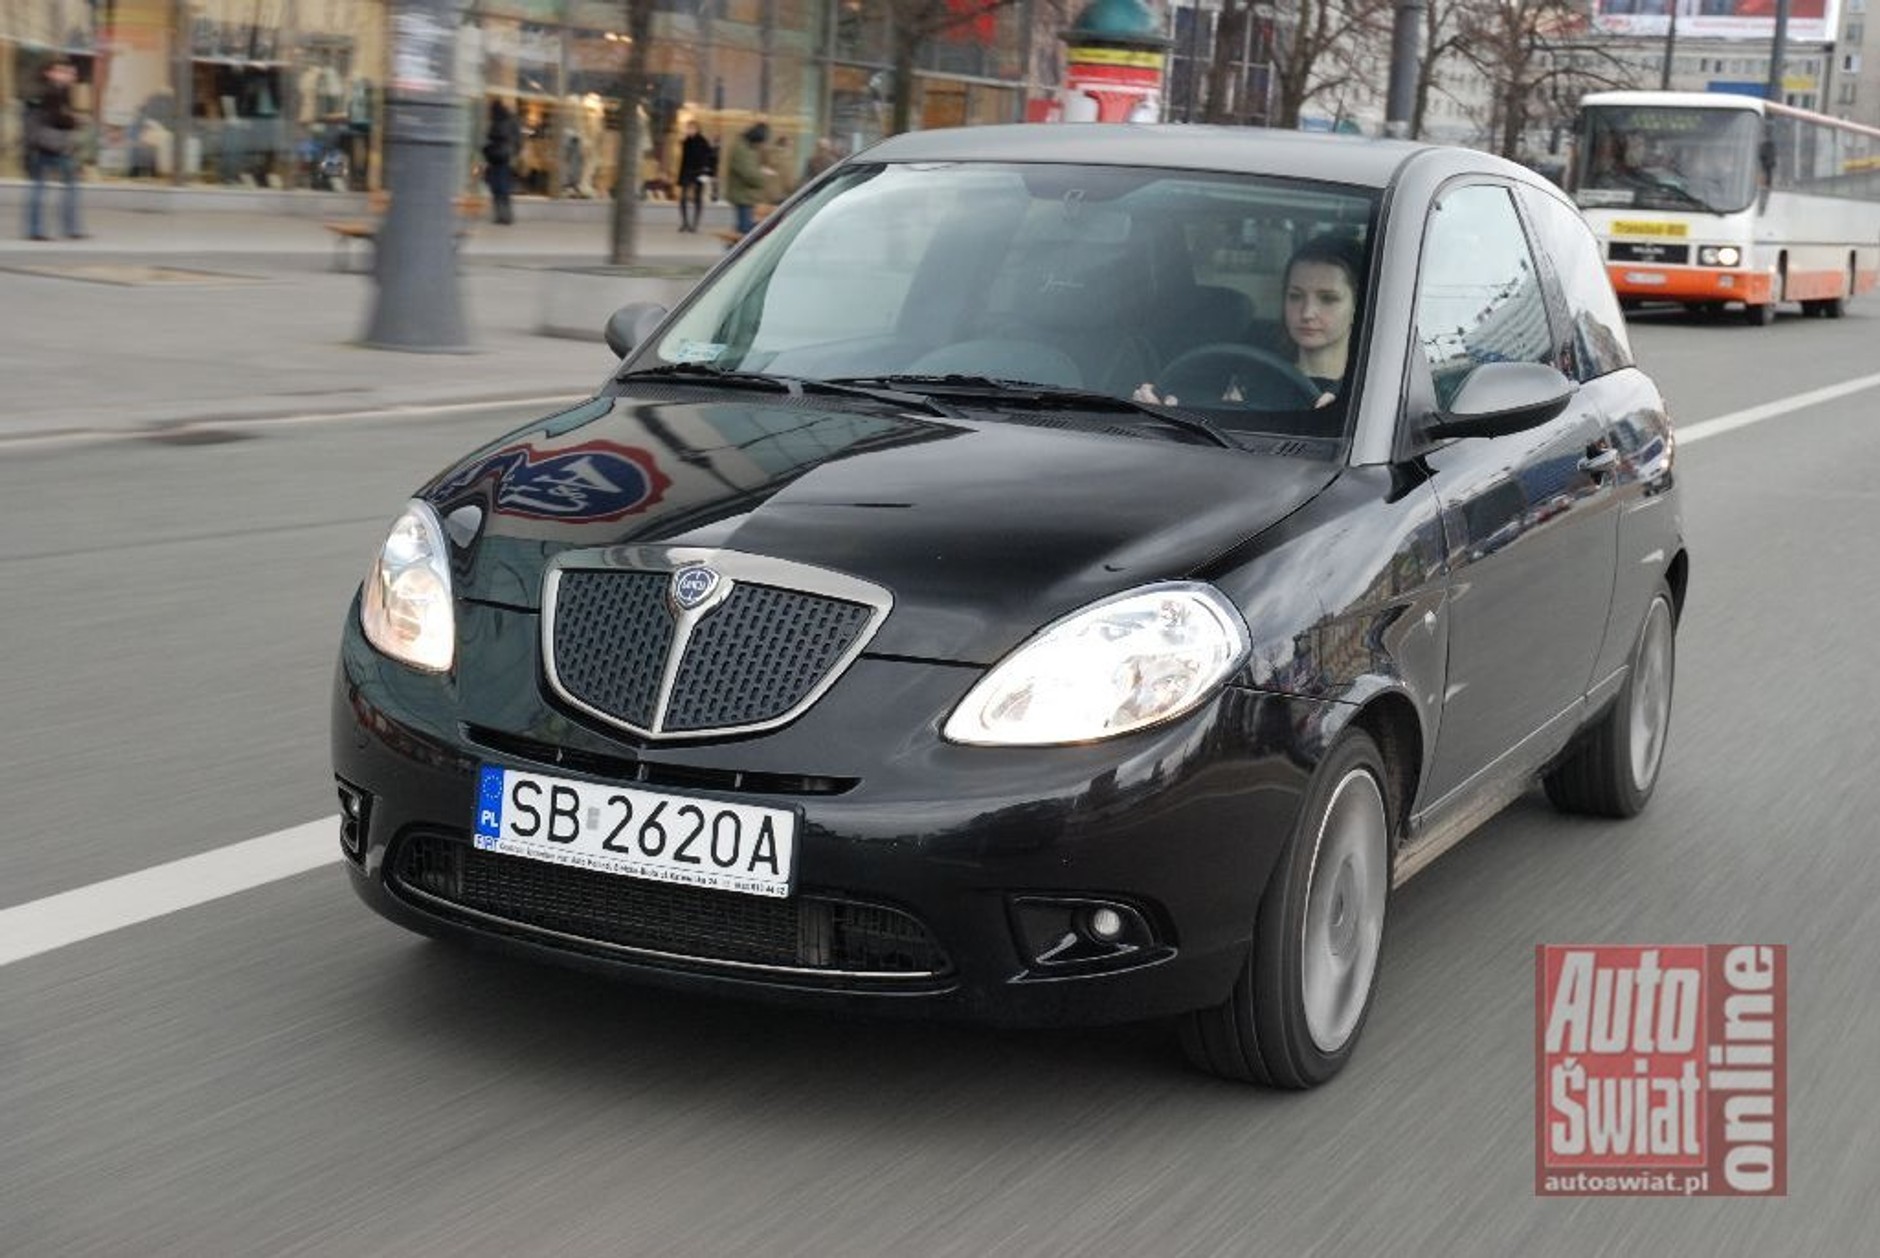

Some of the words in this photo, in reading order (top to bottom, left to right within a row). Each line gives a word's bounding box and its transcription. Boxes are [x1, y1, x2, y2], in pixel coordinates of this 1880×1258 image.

[481, 810, 499, 827] PL
[510, 779, 580, 844] SB
[602, 795, 780, 875] 2620A
